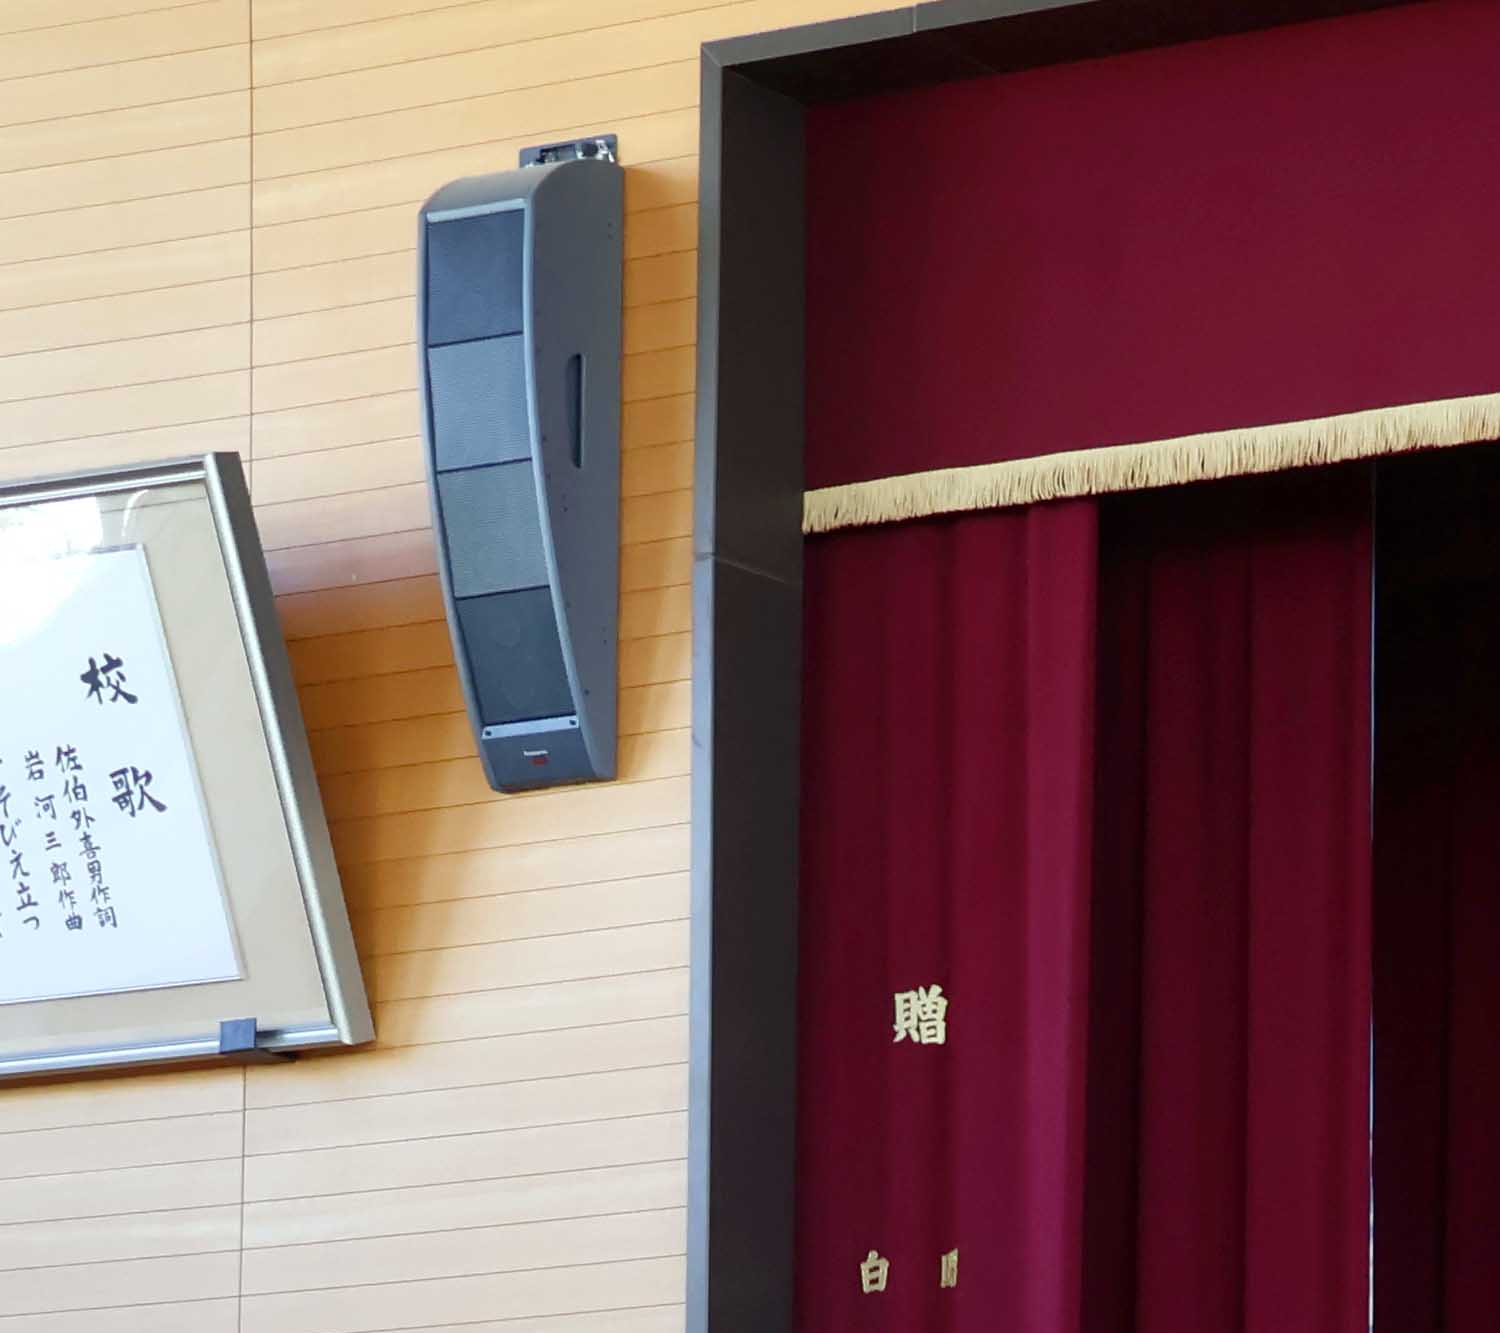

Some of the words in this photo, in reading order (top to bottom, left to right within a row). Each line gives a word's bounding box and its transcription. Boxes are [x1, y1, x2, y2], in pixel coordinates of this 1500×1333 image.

[80, 653, 167, 818] 校歌
[25, 750, 83, 931] 岩河三郎作曲
[893, 984, 948, 1045] 贈
